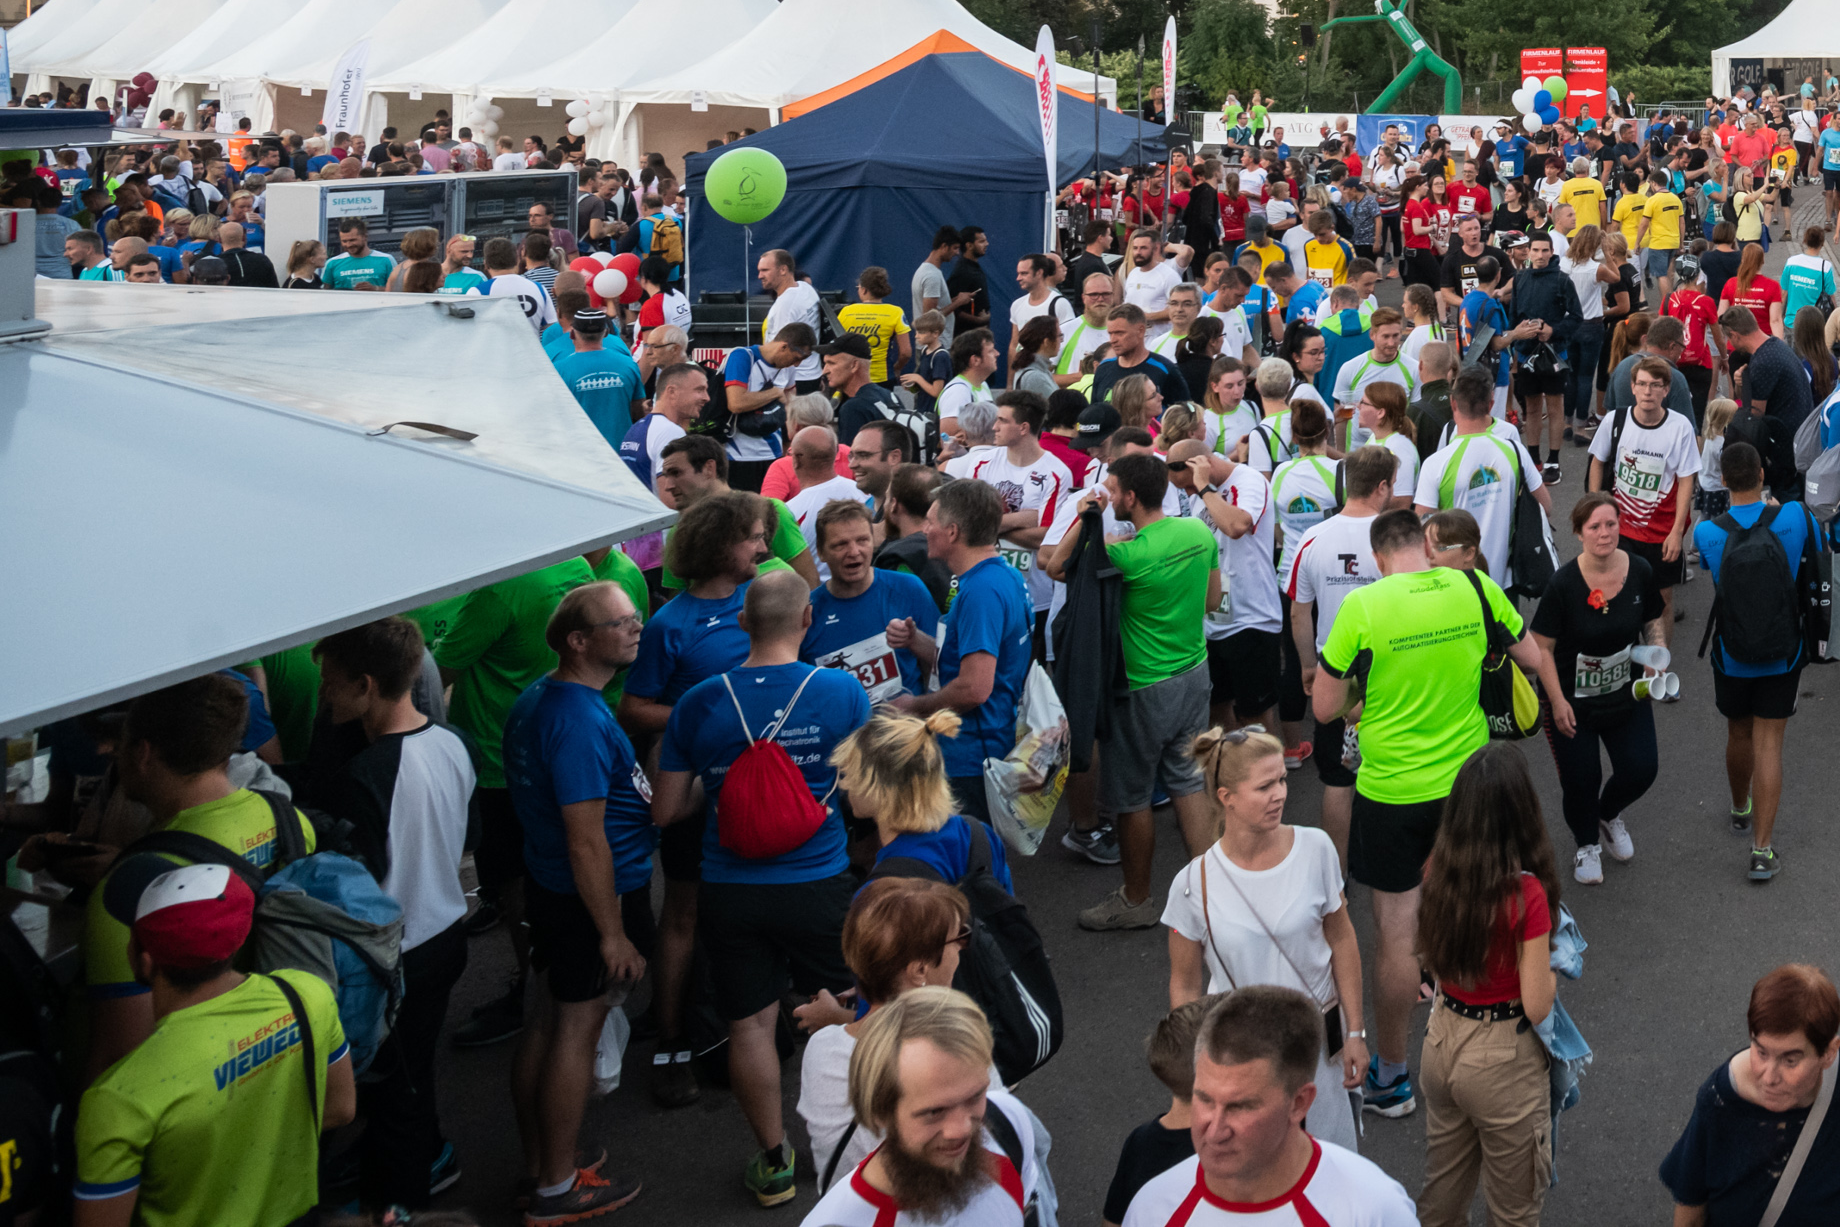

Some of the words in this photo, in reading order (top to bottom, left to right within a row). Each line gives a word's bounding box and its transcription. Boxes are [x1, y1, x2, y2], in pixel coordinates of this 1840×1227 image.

[336, 68, 353, 128] Fraunhofer
[1288, 123, 1313, 133] ATG
[332, 196, 372, 206] SIEMENS
[340, 268, 374, 277] SIEMENS
[1790, 274, 1816, 285] SIEMENS
[847, 323, 881, 334] crivit
[1632, 448, 1664, 459] HÖRMANN
[1621, 465, 1658, 489] 9518
[1776, 527, 1792, 536] mbH
[1000, 550, 1031, 570] 519
[1389, 631, 1433, 646] KOMPETENTER
[1435, 626, 1461, 637] PARTNER
[1392, 630, 1479, 652] AUTOMATISIERUNGSTECHNIK
[1578, 663, 1632, 687] 10585
[781, 726, 808, 737] Institut
[809, 725, 820, 735] für
